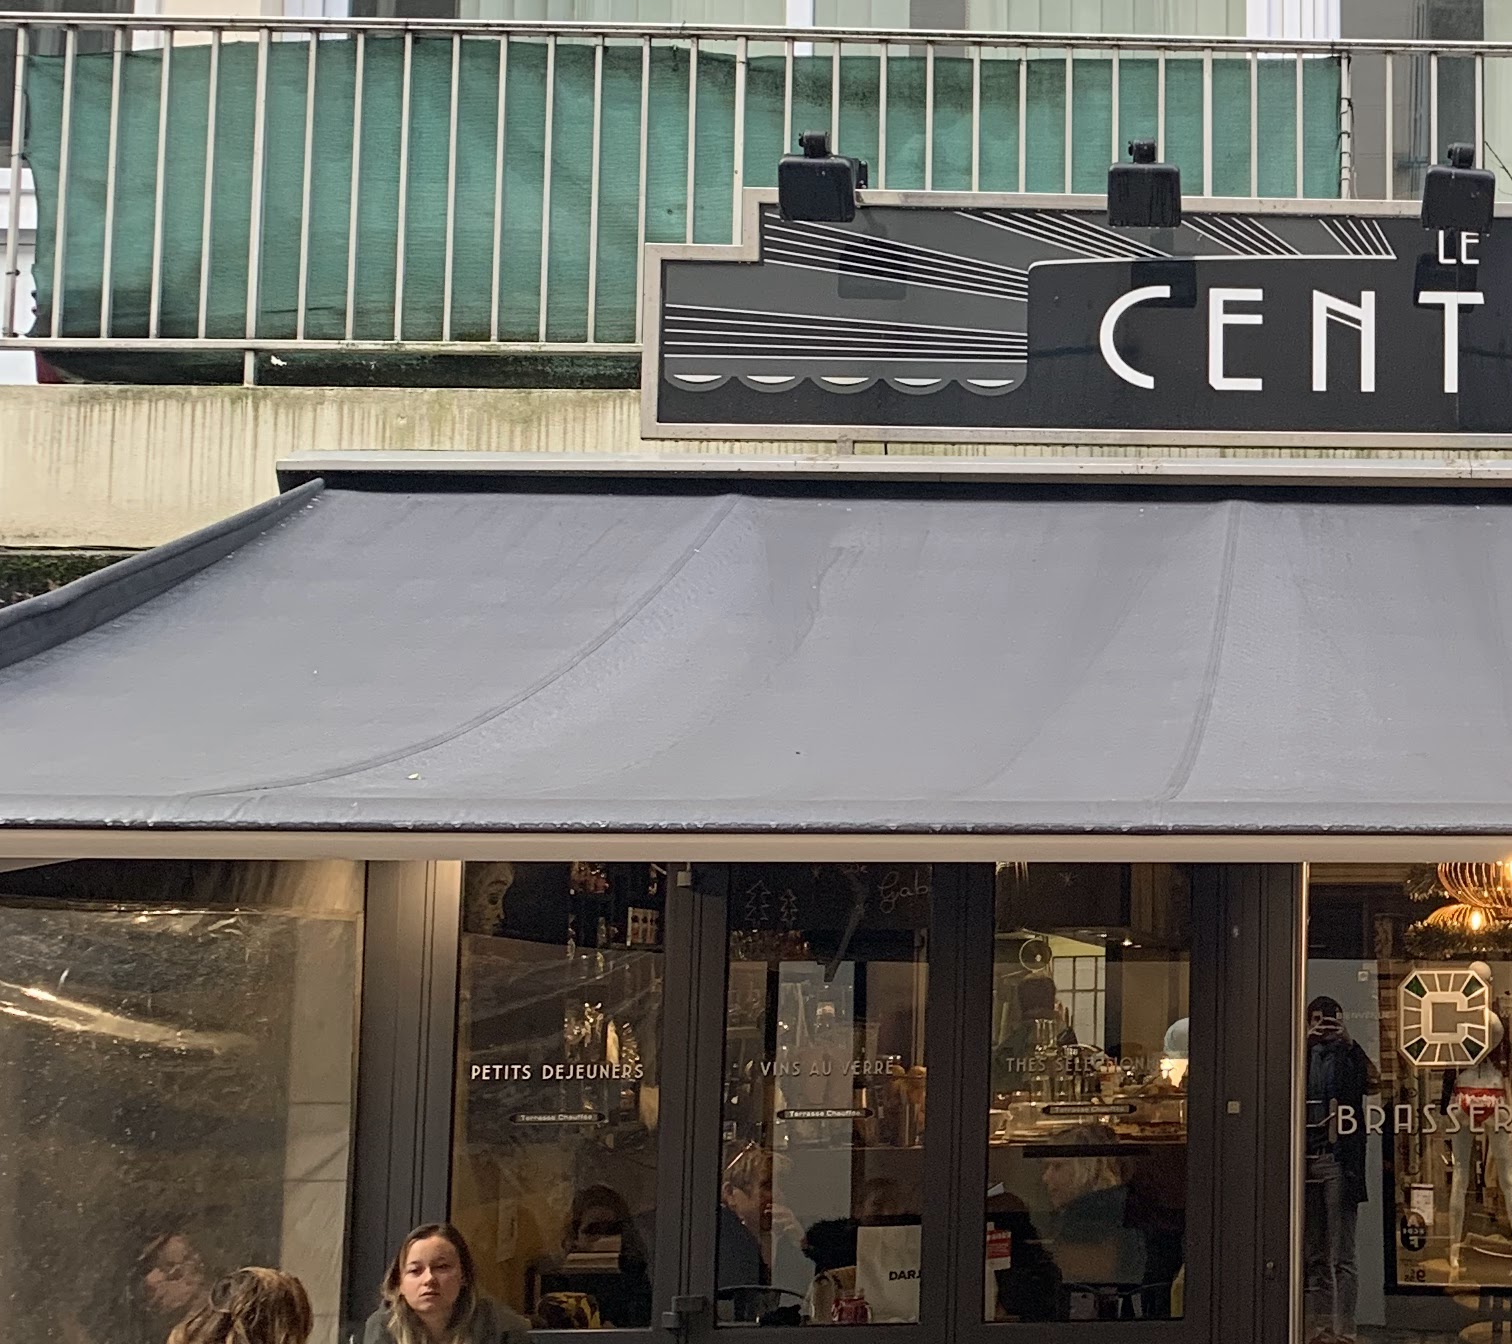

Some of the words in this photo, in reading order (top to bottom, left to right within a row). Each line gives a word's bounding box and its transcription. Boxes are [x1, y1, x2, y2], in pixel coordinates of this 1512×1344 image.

[1438, 230, 1481, 265] LE
[470, 1064, 531, 1080] PETITS
[542, 1063, 644, 1080] DEJEUNERS
[760, 1061, 801, 1076] VINS
[809, 1061, 832, 1076] AU
[841, 1059, 894, 1075] VERRE
[1005, 1057, 1046, 1072] THES
